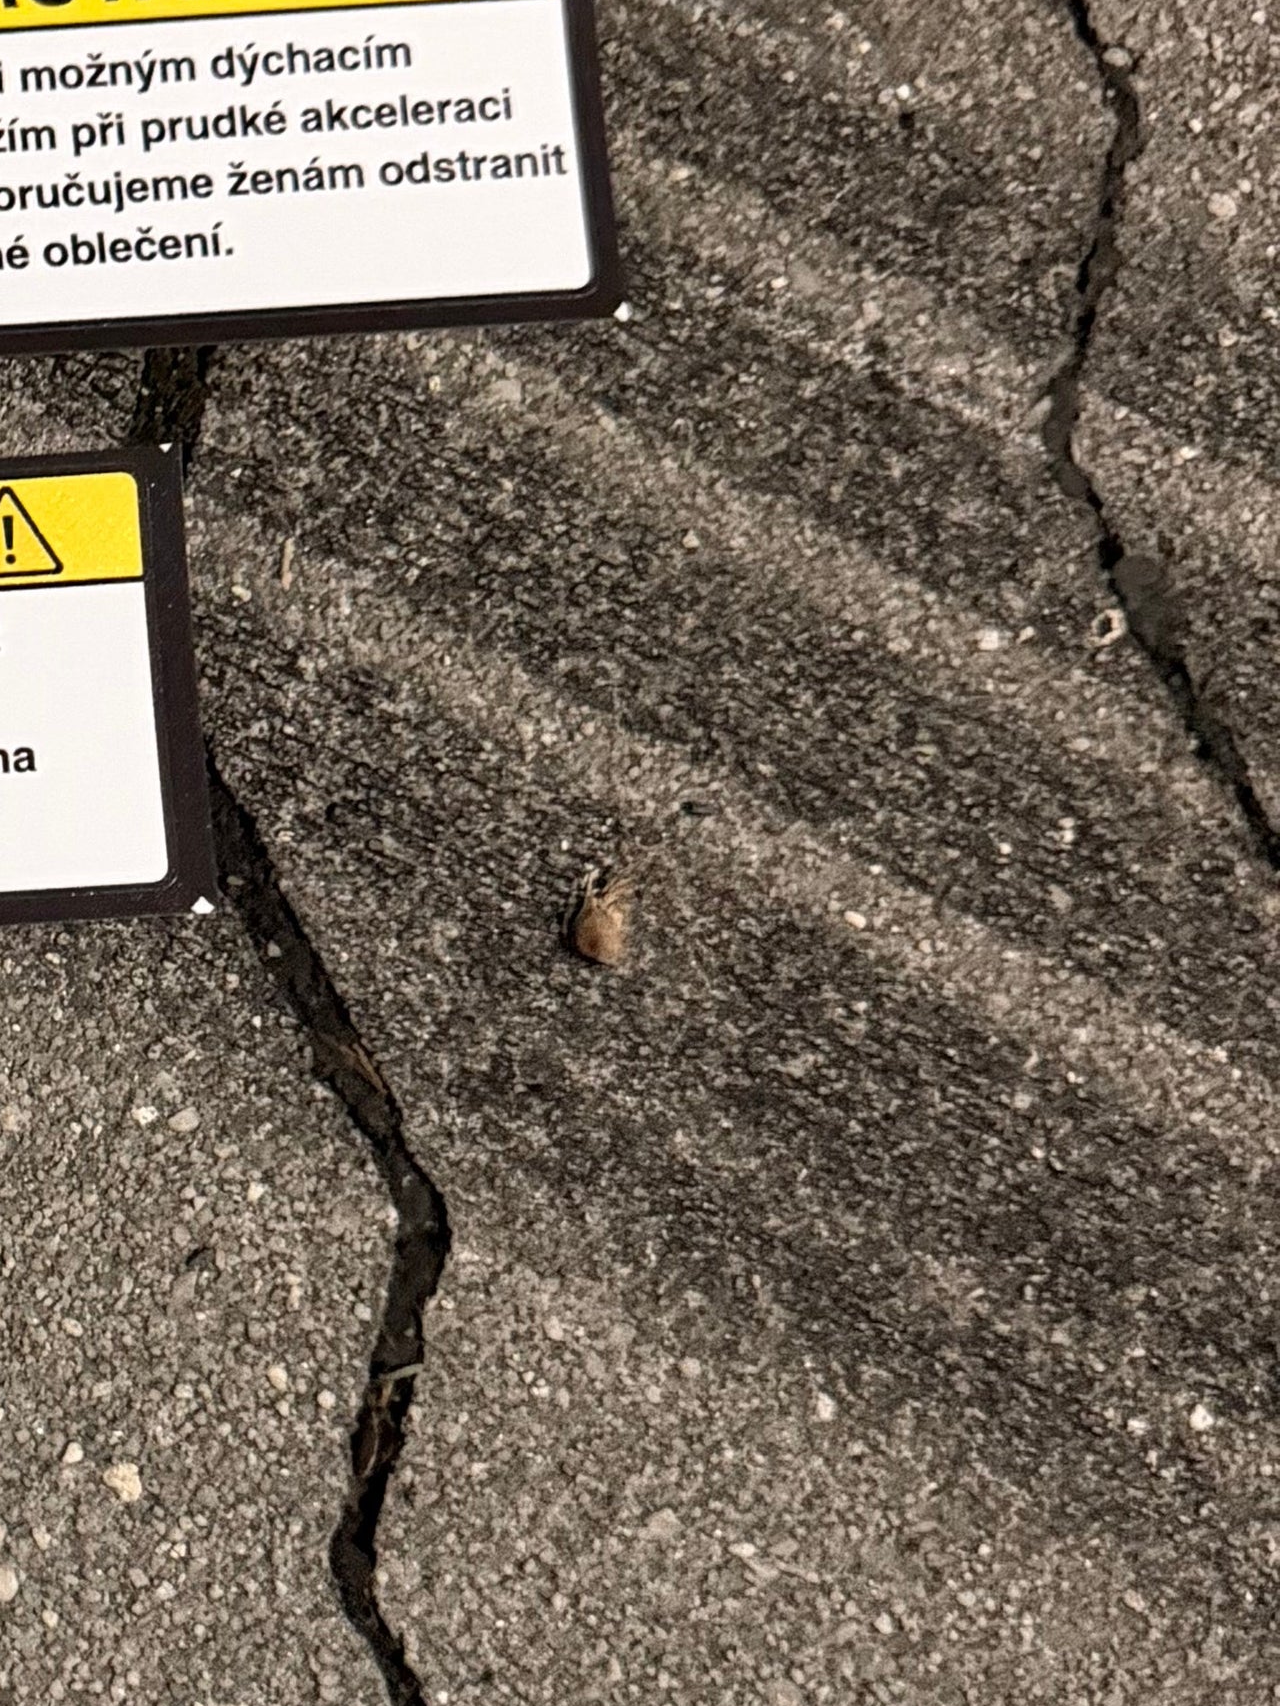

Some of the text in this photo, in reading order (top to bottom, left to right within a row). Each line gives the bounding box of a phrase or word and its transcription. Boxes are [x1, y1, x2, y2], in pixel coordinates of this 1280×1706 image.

[19, 52, 197, 94] možným
[210, 35, 413, 88] dýchacím
[71, 111, 126, 158] při
[140, 104, 287, 153] prudké
[300, 88, 513, 135] akceleraci
[227, 161, 366, 197] ženám
[379, 145, 567, 187] odstranit
[42, 221, 235, 269] oblečení.
